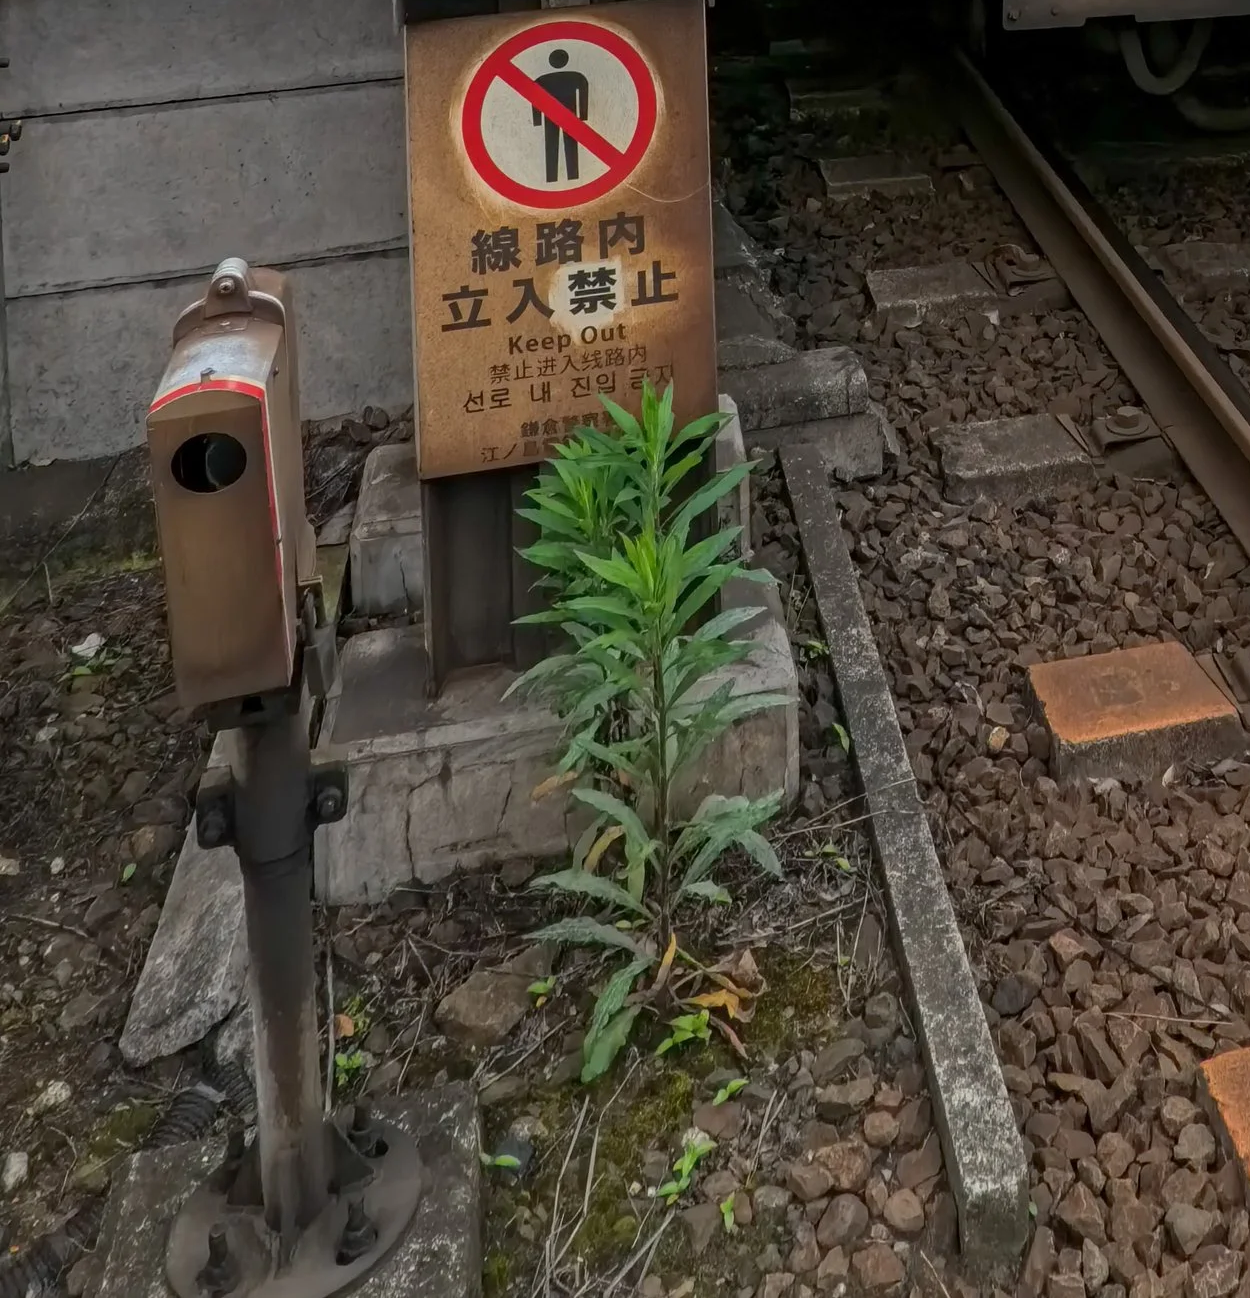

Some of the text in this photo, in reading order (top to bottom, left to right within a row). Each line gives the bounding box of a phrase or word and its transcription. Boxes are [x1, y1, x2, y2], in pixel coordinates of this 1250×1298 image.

[471, 212, 645, 275] 線路内
[441, 260, 679, 332] 立入禁止
[509, 323, 627, 355] Keep Out
[490, 344, 647, 384] 禁止进入线路内
[463, 387, 512, 414] 선로
[530, 381, 551, 403] 내
[571, 372, 616, 398] 진입
